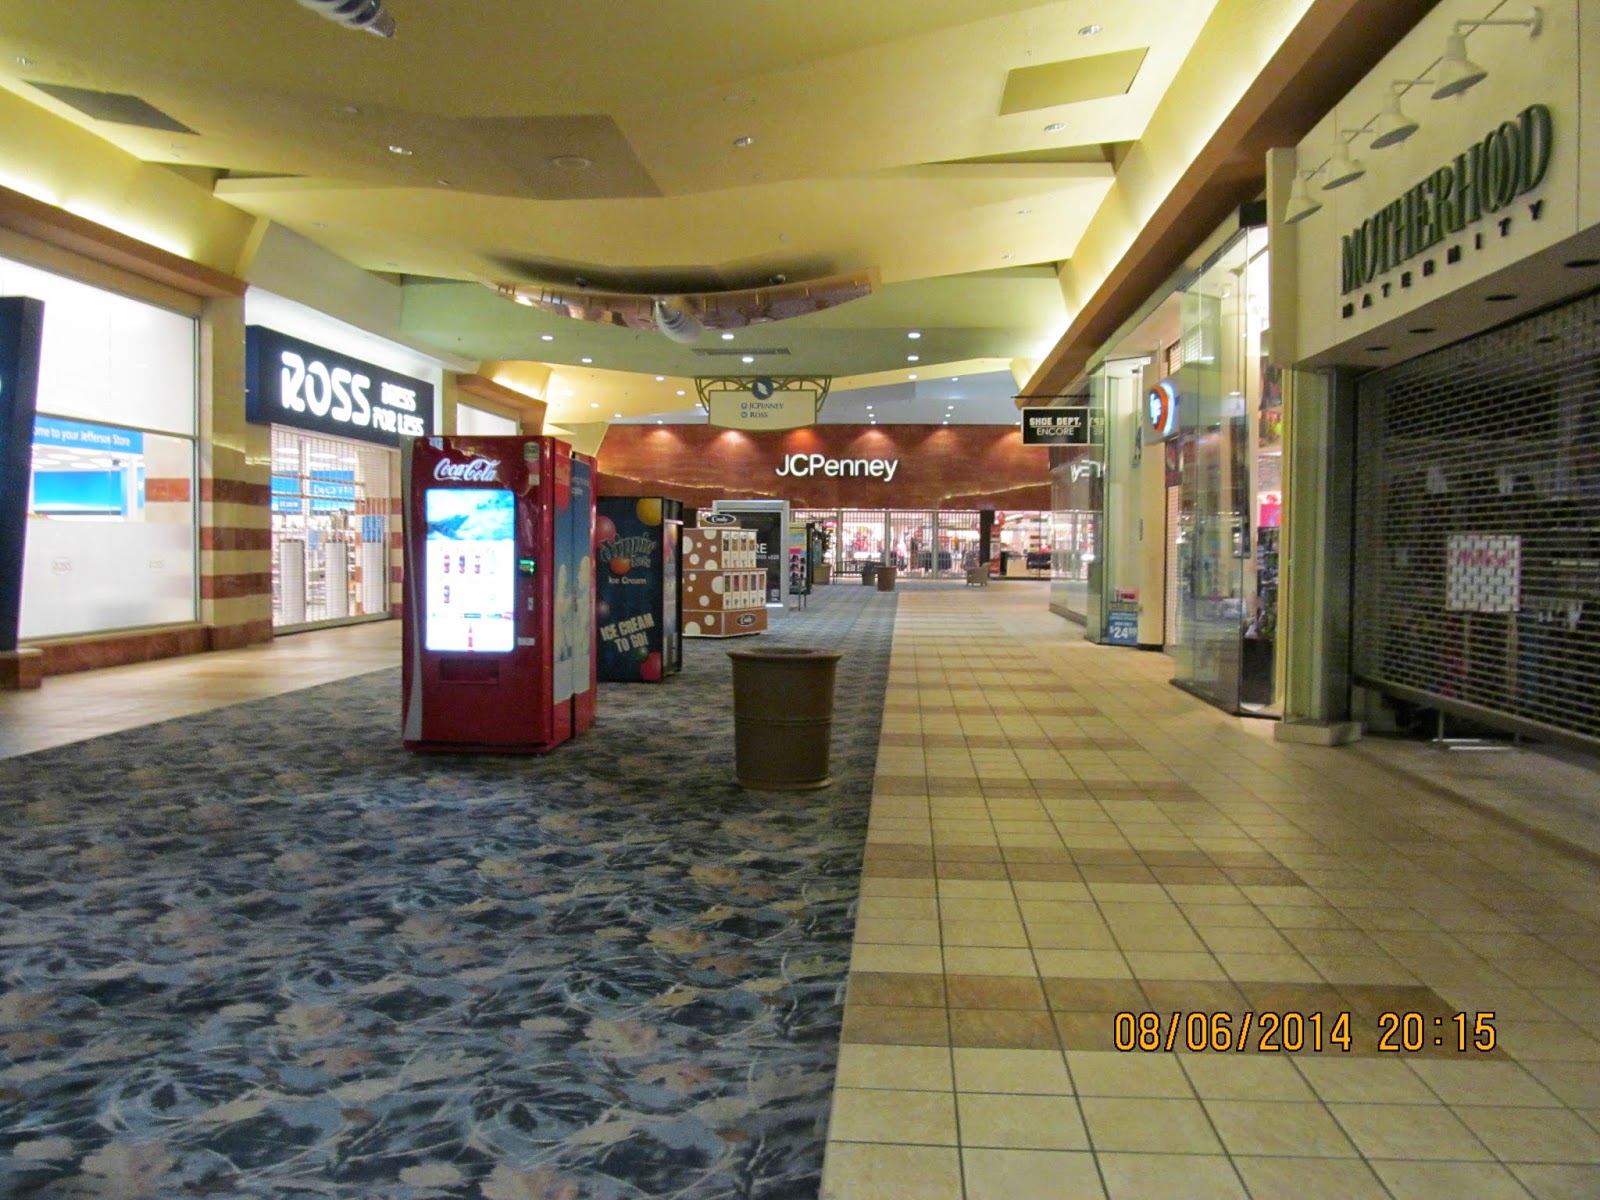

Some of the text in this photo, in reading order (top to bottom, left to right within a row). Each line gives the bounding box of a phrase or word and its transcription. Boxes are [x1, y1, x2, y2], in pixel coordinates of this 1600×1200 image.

[1341, 103, 1553, 296] MOTHERHOOD
[1342, 199, 1545, 319] MATERNITY
[281, 351, 370, 426] ROSS
[749, 402, 784, 410] JCPENNEY
[373, 406, 424, 436] FOR LESS
[1029, 417, 1053, 426] SHOE
[1056, 416, 1082, 426] DEPT.
[1036, 427, 1075, 436] ENCORE
[775, 453, 899, 482] JCPenney
[608, 576, 648, 585] Ice Cream
[600, 612, 655, 641] ICE CREAM
[614, 631, 649, 653] TO GO!
